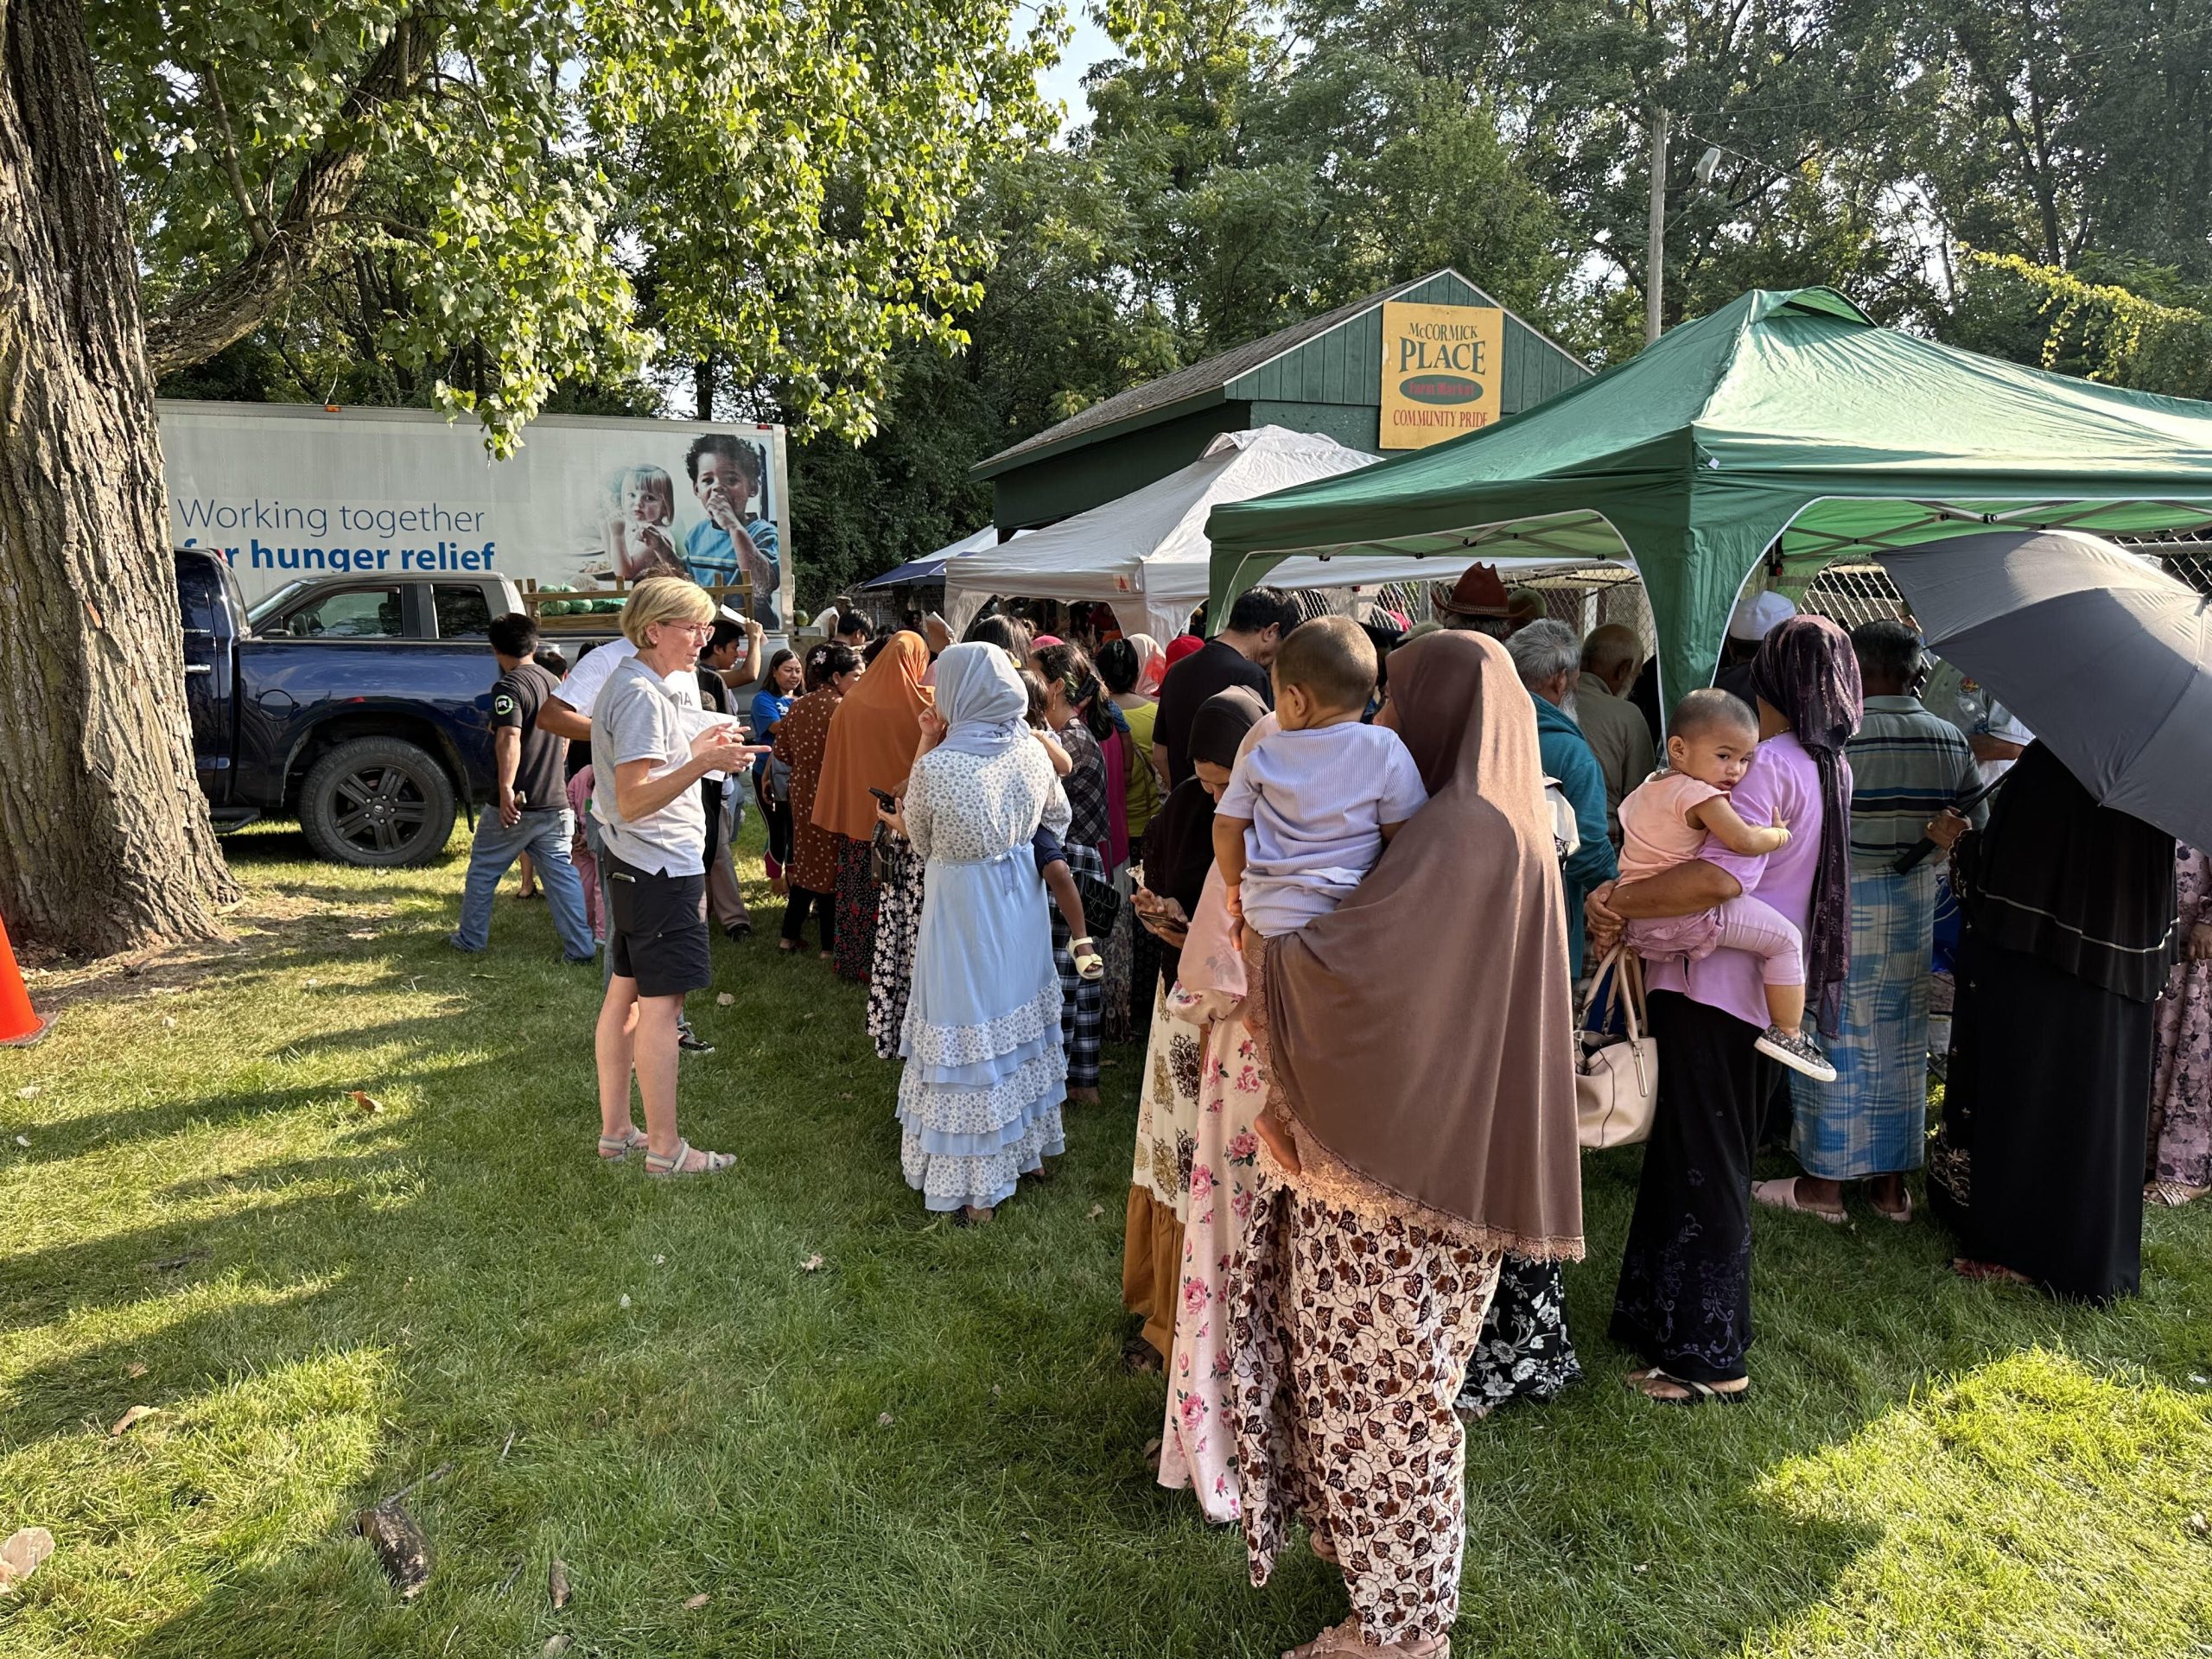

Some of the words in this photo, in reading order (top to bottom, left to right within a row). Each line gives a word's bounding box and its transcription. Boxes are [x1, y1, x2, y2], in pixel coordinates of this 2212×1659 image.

[1408, 322, 1478, 341] McCORMICK
[1398, 336, 1486, 376] PLACE
[1393, 409, 1456, 427] COMMUNITY
[177, 498, 327, 537] Working
[339, 502, 486, 539] together
[251, 538, 391, 573] hunger
[401, 541, 496, 571] relief
